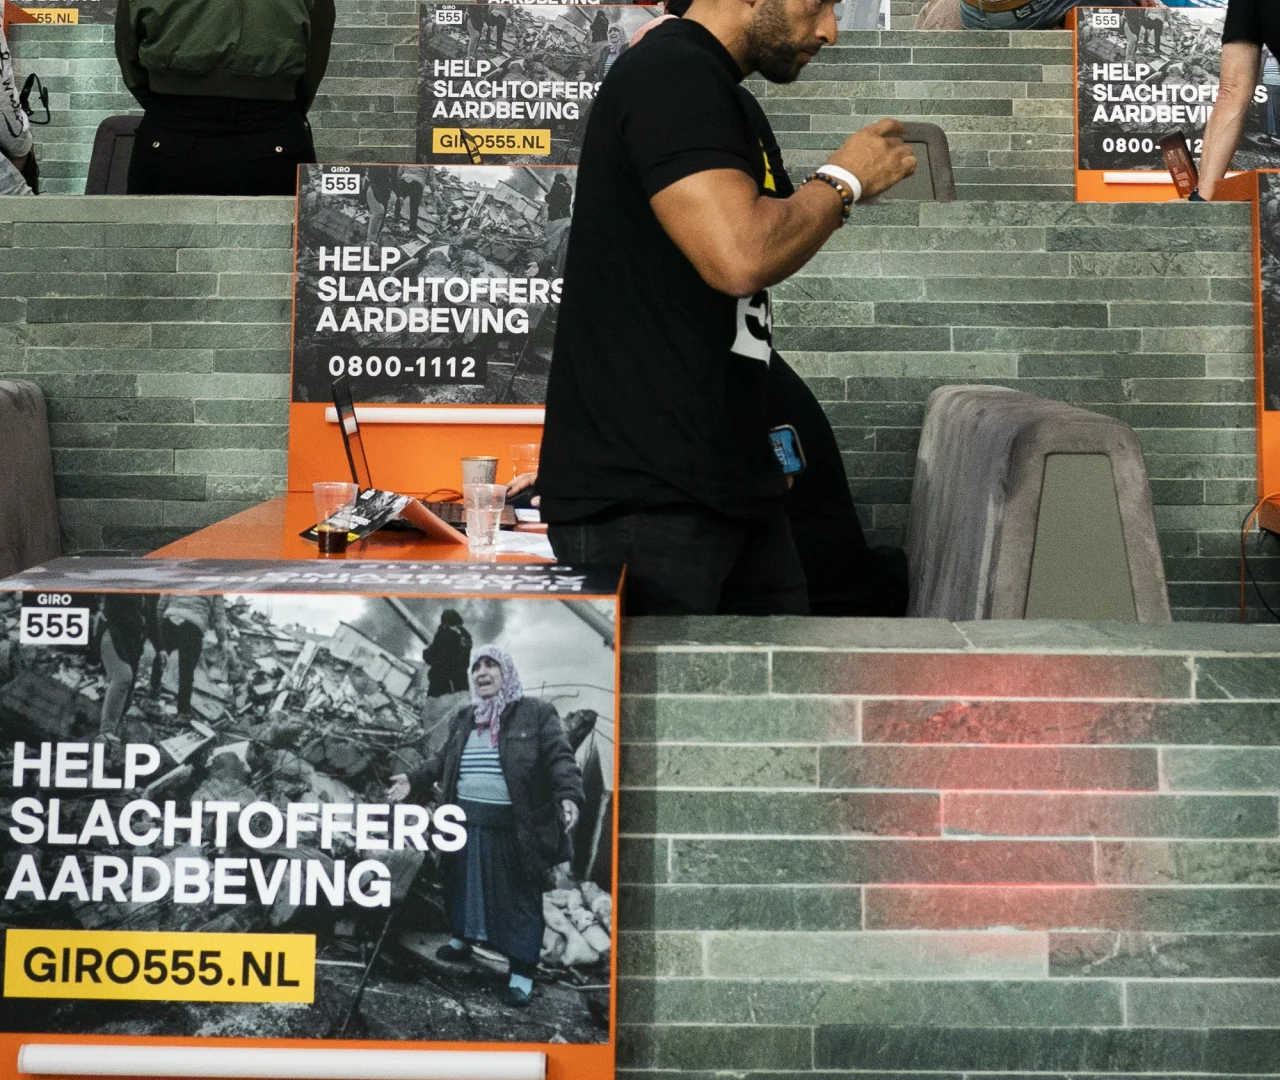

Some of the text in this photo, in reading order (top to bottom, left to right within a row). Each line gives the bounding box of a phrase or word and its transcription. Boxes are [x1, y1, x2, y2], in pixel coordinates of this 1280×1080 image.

[438, 12, 461, 22] 555
[1095, 16, 1117, 25] 555
[434, 60, 491, 77] HELP
[1093, 63, 1150, 81] HELP
[432, 101, 579, 120] AARDBEVING
[325, 176, 357, 191] 555
[319, 246, 401, 272] HELP
[316, 307, 529, 334] AARDBEVING
[328, 355, 476, 377] 0800-1112
[37, 594, 72, 605] GIRO
[26, 613, 84, 638] 555
[12, 741, 161, 790] HELP
[9, 798, 468, 852] SLACHTOFFERS
[5, 855, 391, 907] AARDBEVING
[23, 946, 300, 988] GIRO555.NL
